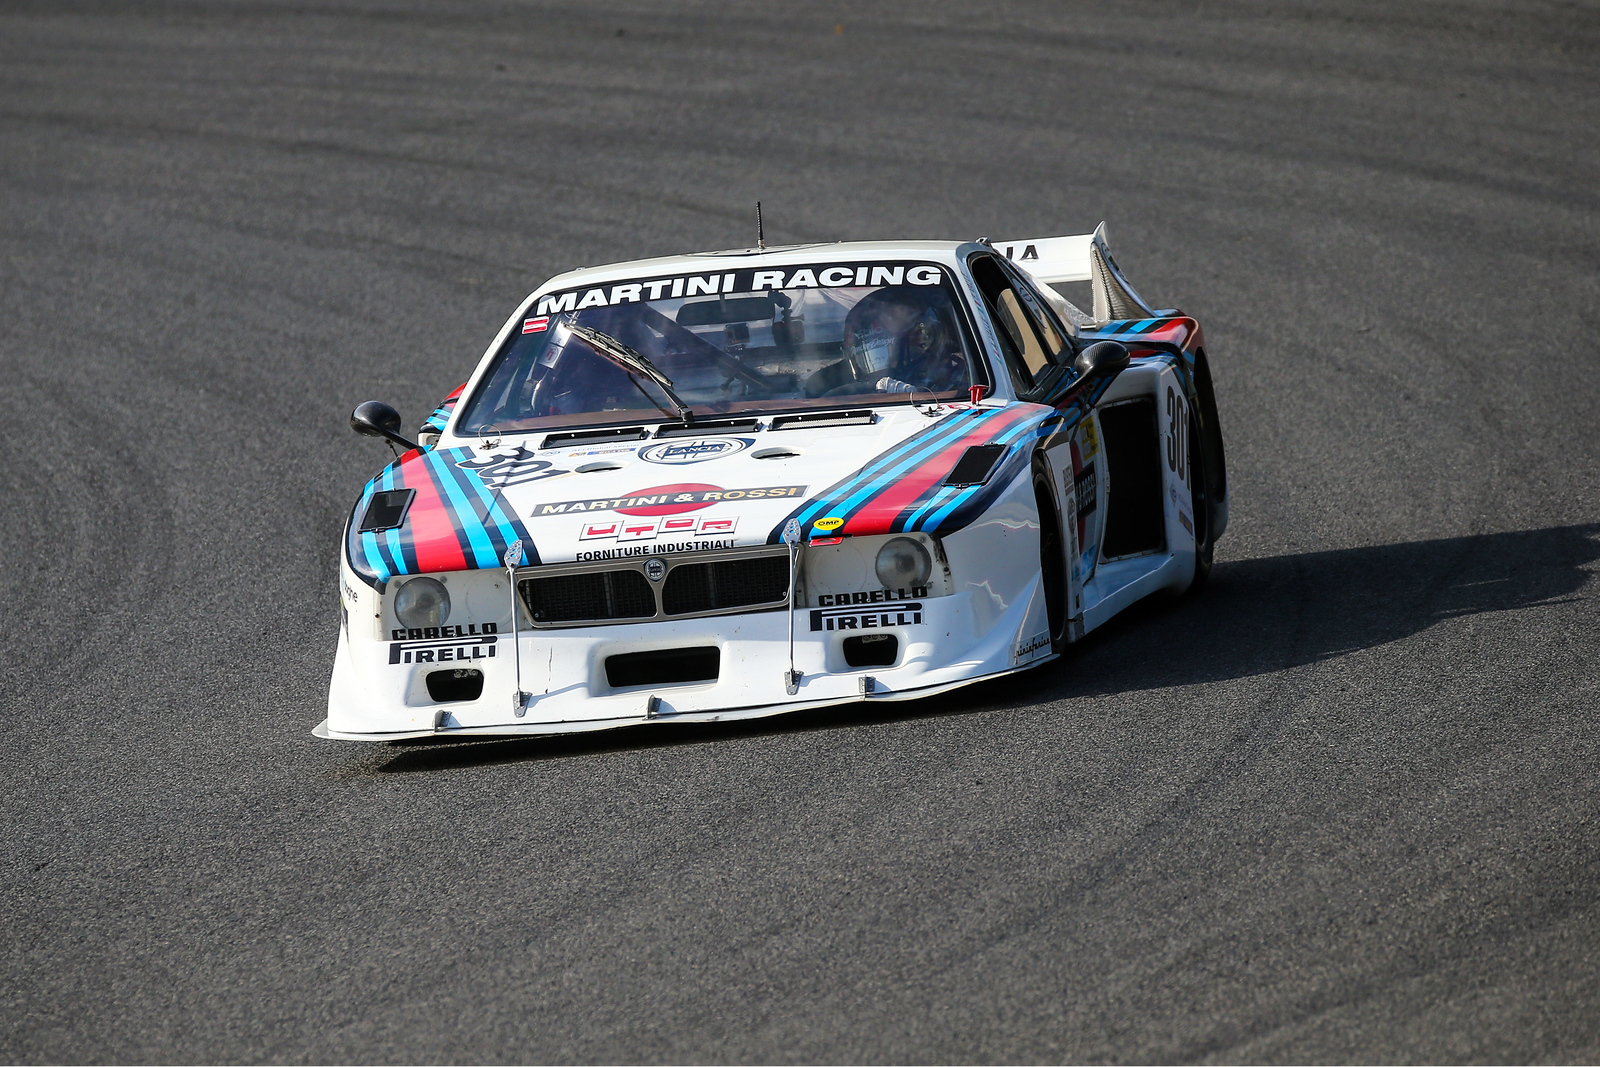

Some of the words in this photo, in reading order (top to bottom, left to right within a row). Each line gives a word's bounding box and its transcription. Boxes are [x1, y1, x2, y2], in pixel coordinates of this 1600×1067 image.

[536, 273, 736, 316] MARTINI
[751, 266, 942, 291] RACING
[668, 444, 722, 455] LANCIA
[455, 446, 571, 488] 301
[541, 495, 668, 515] MARTINI
[674, 493, 695, 503] &
[703, 487, 797, 501] ROSSI
[576, 544, 650, 562] FORNITURE
[653, 540, 735, 555] INDUSTRIALI
[818, 586, 928, 607] CARELLO
[809, 602, 923, 632] PIRELLI
[391, 622, 498, 641] CARELLO
[388, 635, 498, 665] PIRELLI
